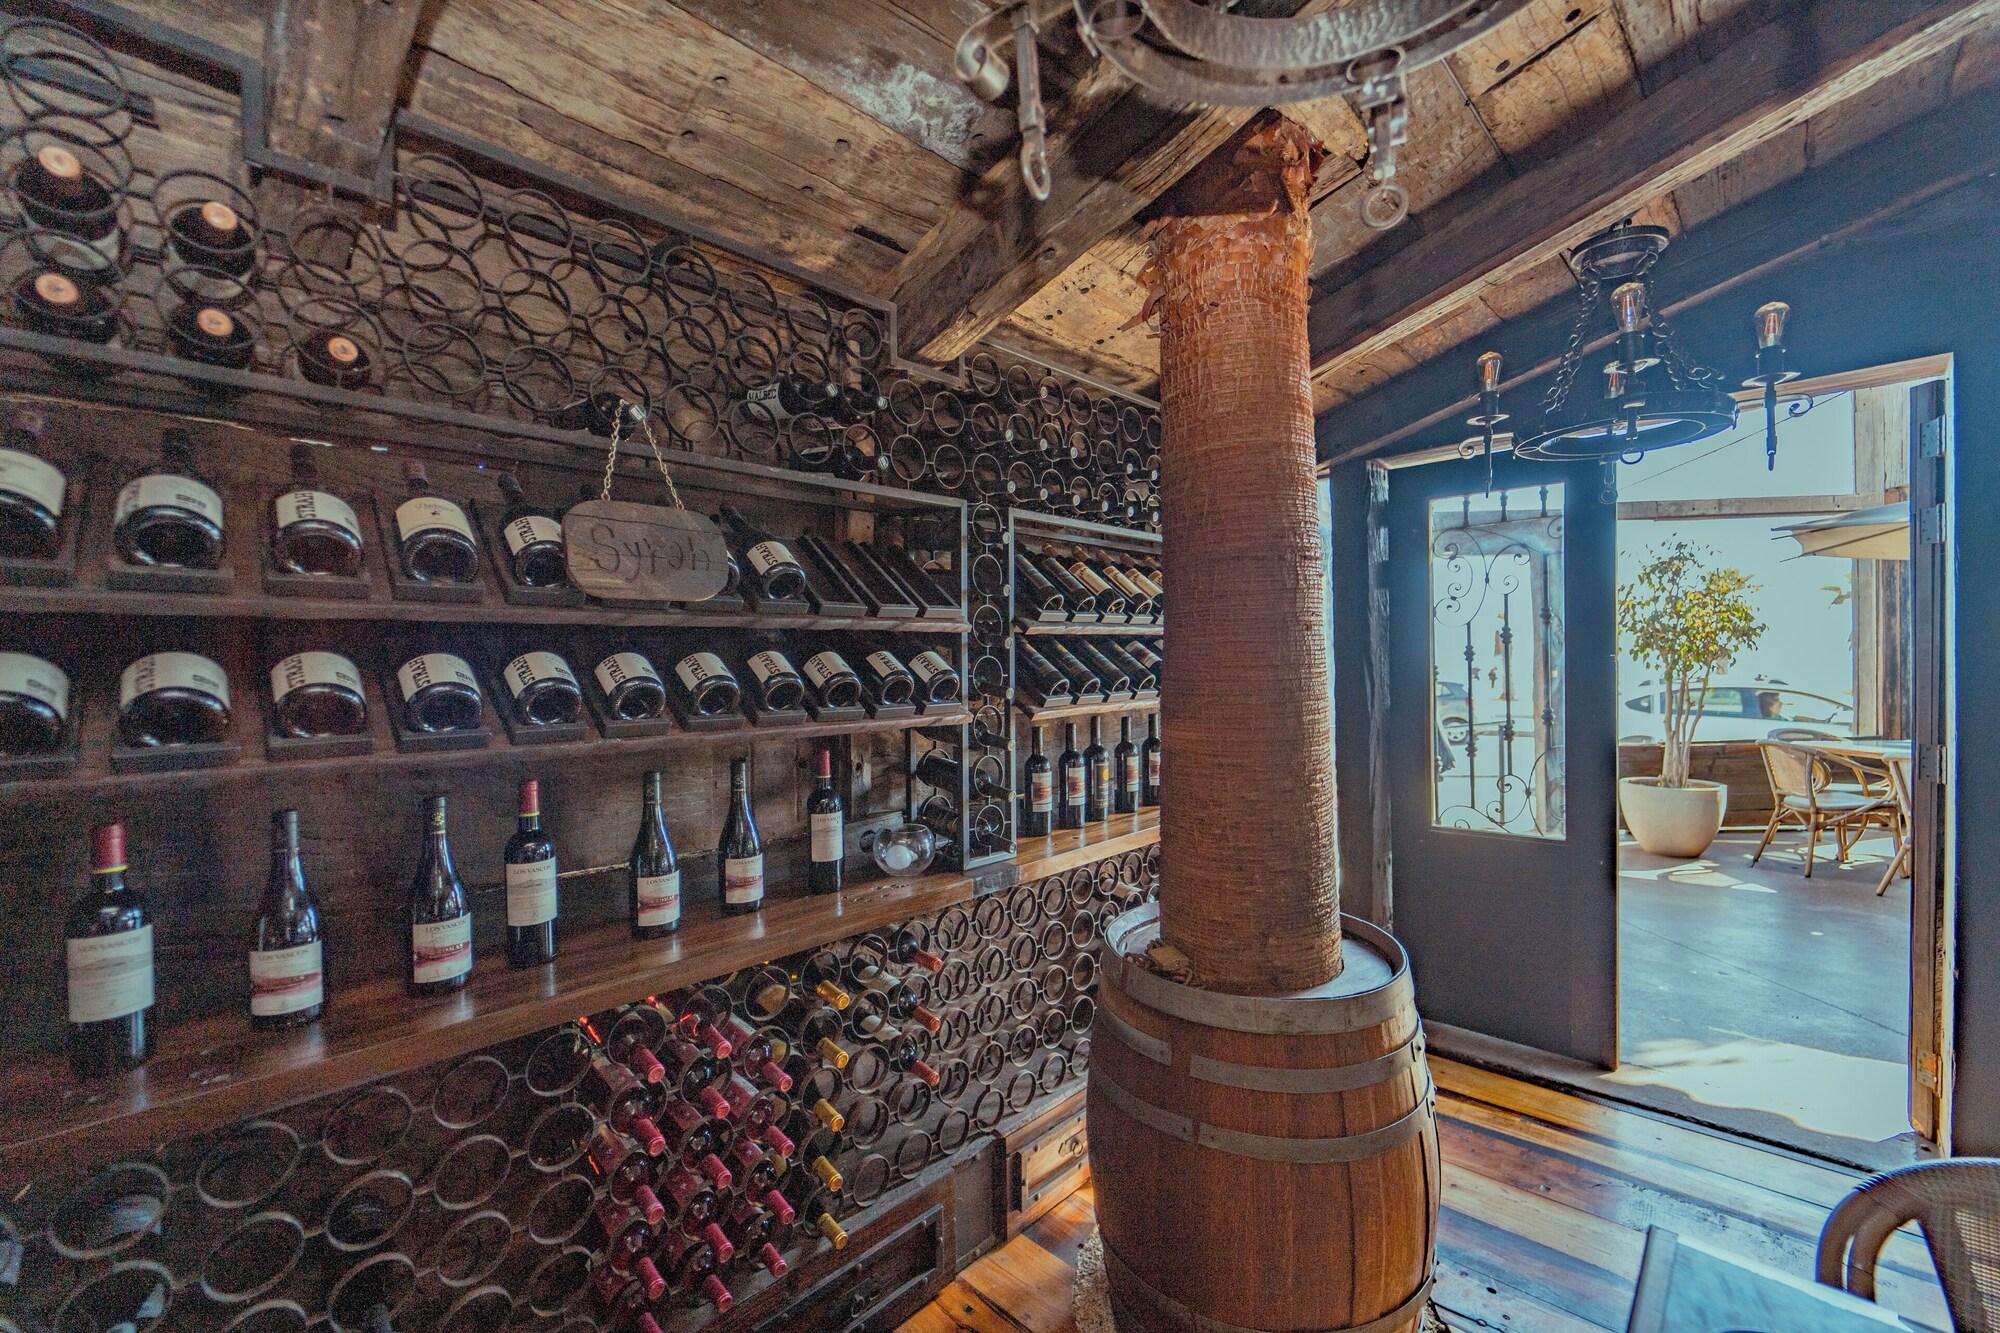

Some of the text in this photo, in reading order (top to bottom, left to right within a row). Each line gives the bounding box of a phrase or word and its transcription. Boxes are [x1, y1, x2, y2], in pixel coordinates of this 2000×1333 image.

[514, 518, 537, 544] SYRAH
[590, 523, 711, 582] Syrah
[755, 543, 778, 566] SYRAH
[408, 657, 431, 688] SYRAH
[512, 656, 536, 686] SYRAH
[603, 656, 626, 683] SYRAH
[684, 655, 708, 681] SYRAH
[757, 652, 780, 674] SYRAH
[810, 656, 832, 679] SYRAH
[916, 654, 939, 674] SYRAH
